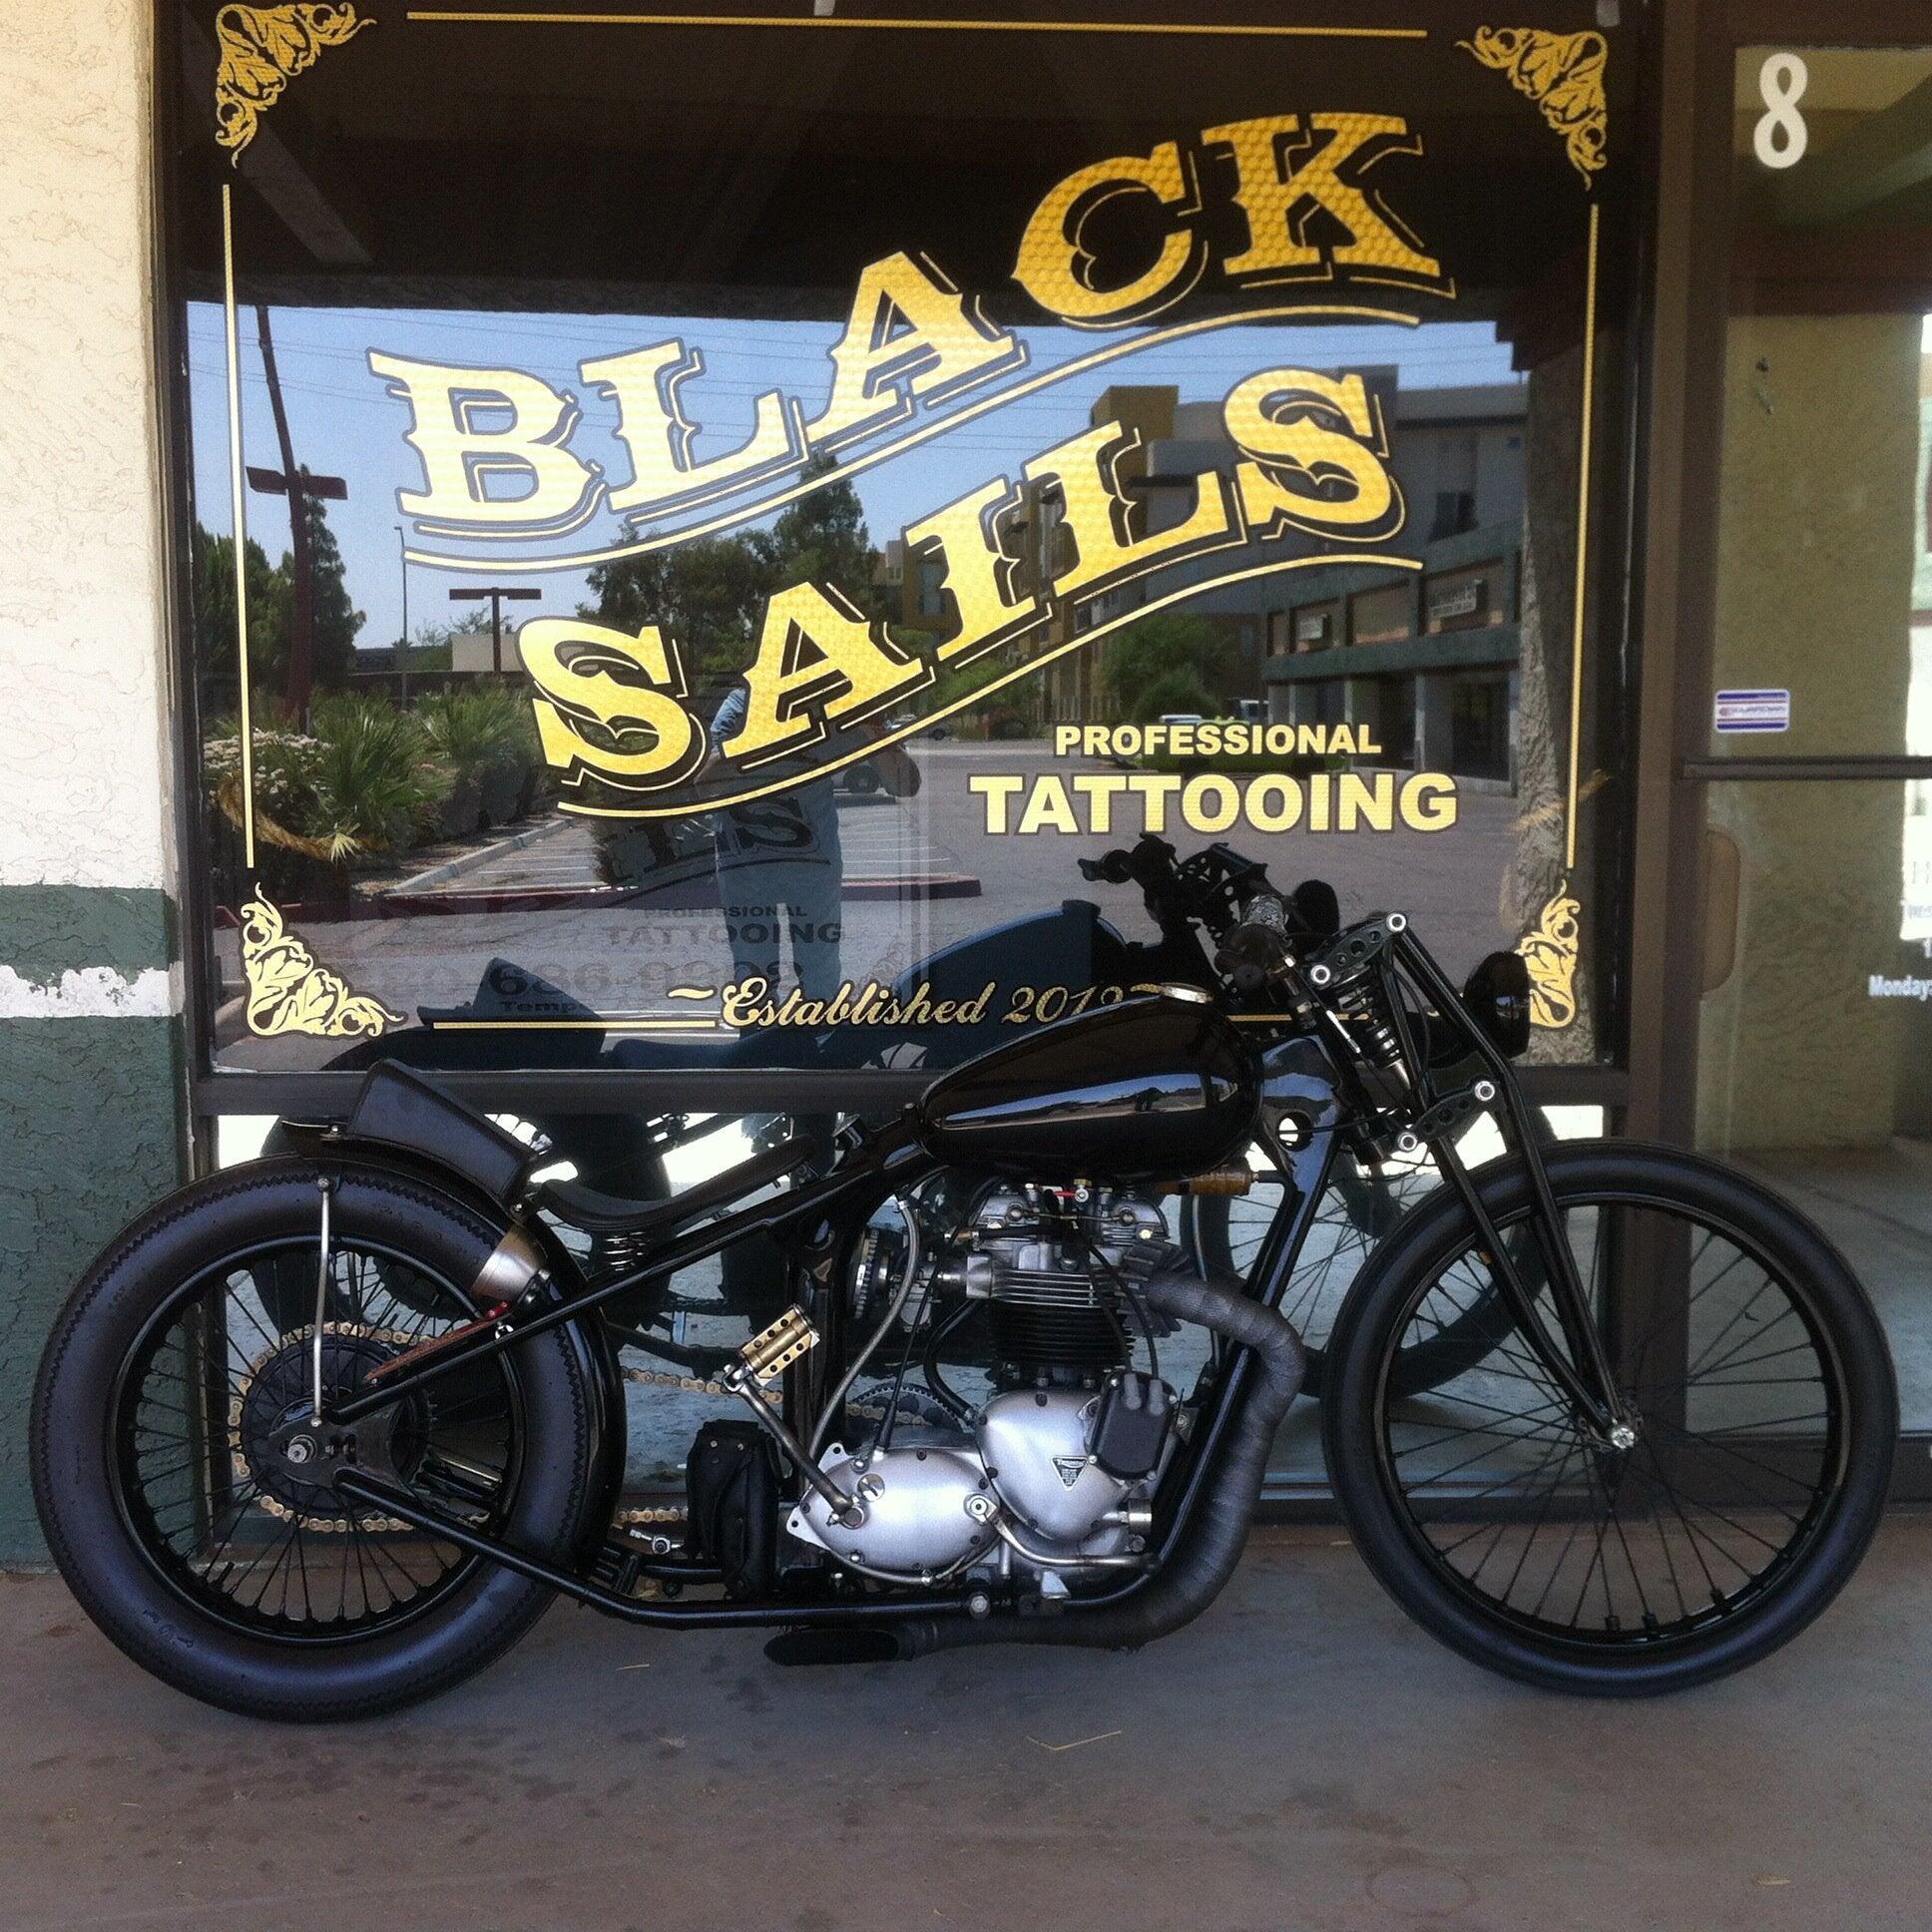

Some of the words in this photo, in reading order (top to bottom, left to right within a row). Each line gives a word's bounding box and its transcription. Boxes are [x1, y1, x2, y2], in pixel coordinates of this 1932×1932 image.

[1753, 52, 1807, 169] 8
[369, 113, 1447, 531] BLACK
[516, 367, 1399, 784] SAILS
[1054, 724, 1382, 756] PROFESSIONAL
[969, 772, 1458, 834] TATTOOING
[721, 976, 996, 1028] Established
